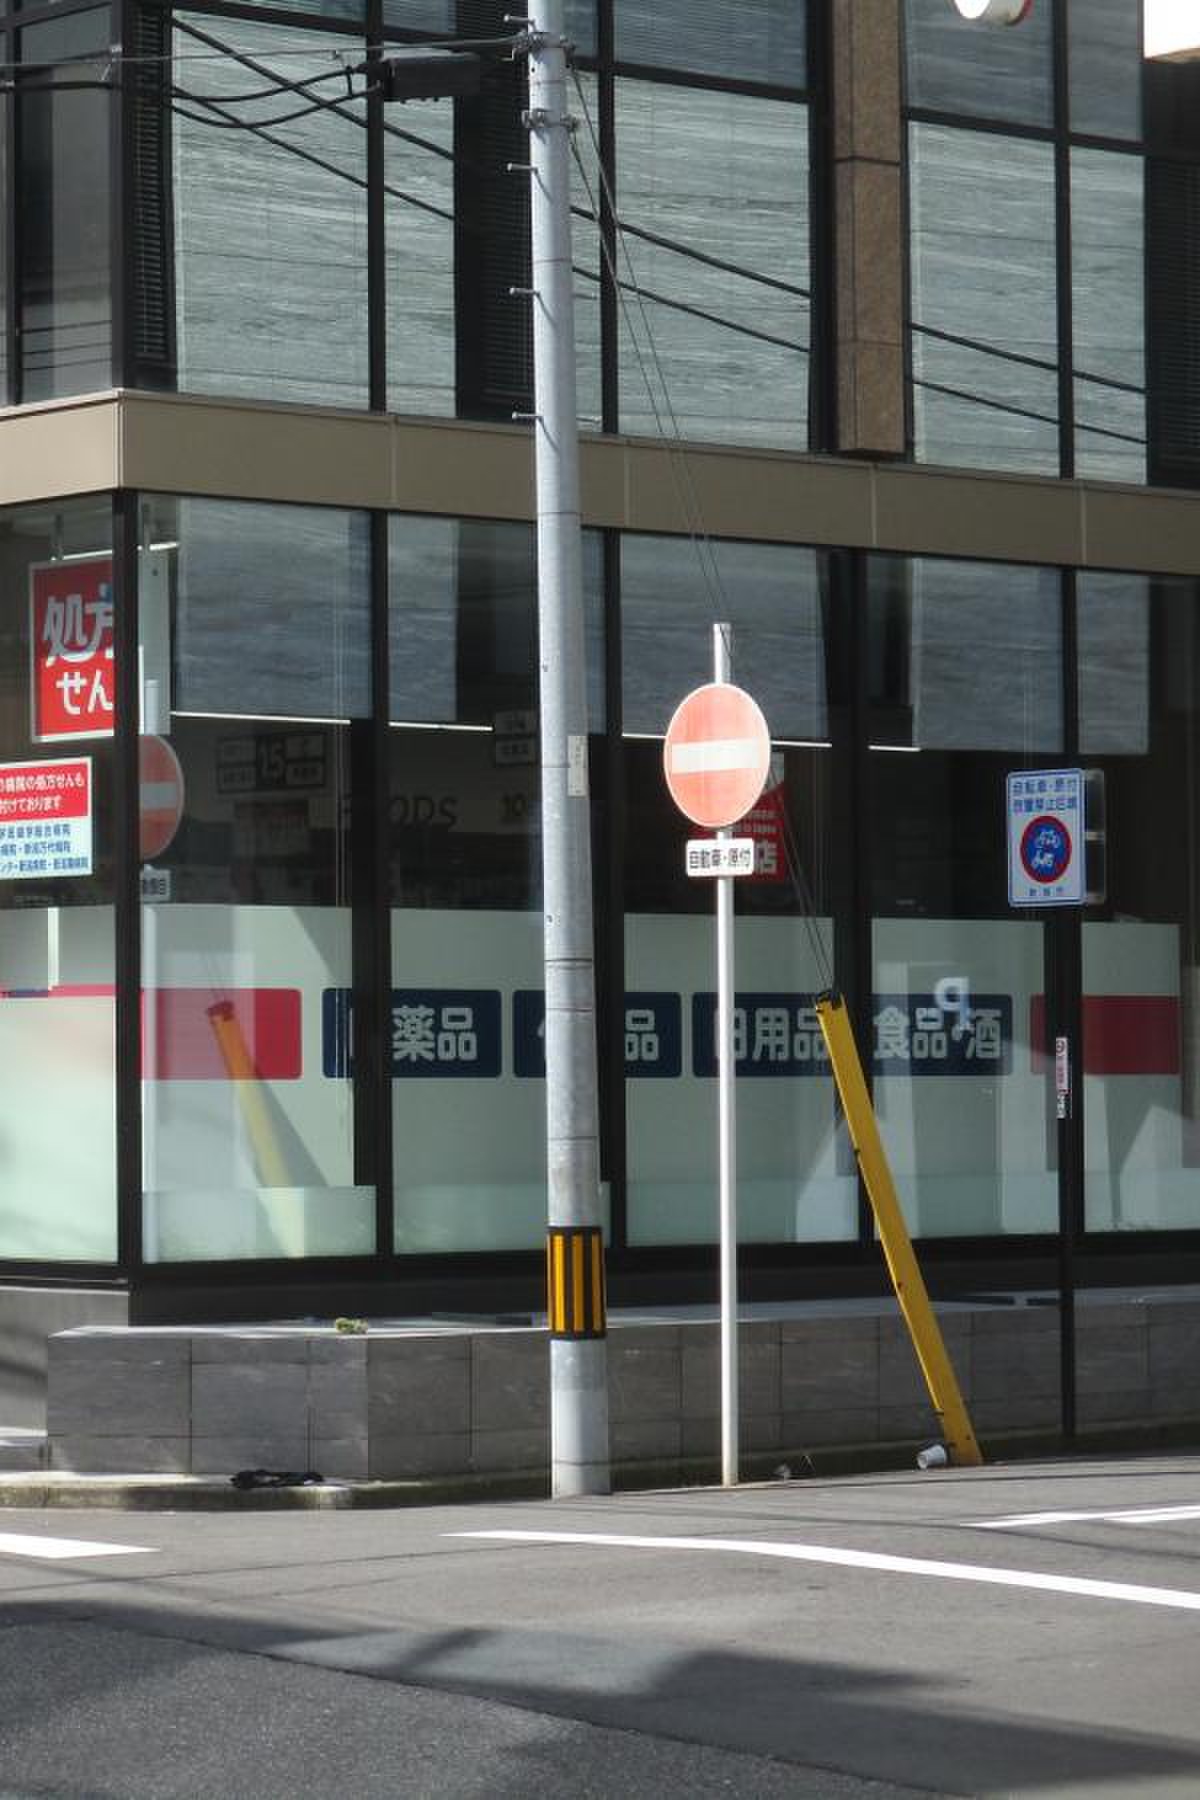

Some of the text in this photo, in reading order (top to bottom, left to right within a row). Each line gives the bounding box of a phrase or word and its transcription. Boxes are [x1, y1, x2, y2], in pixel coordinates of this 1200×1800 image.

[689, 848, 751, 870] 自動車・原付
[350, 1005, 478, 1062] 薬品
